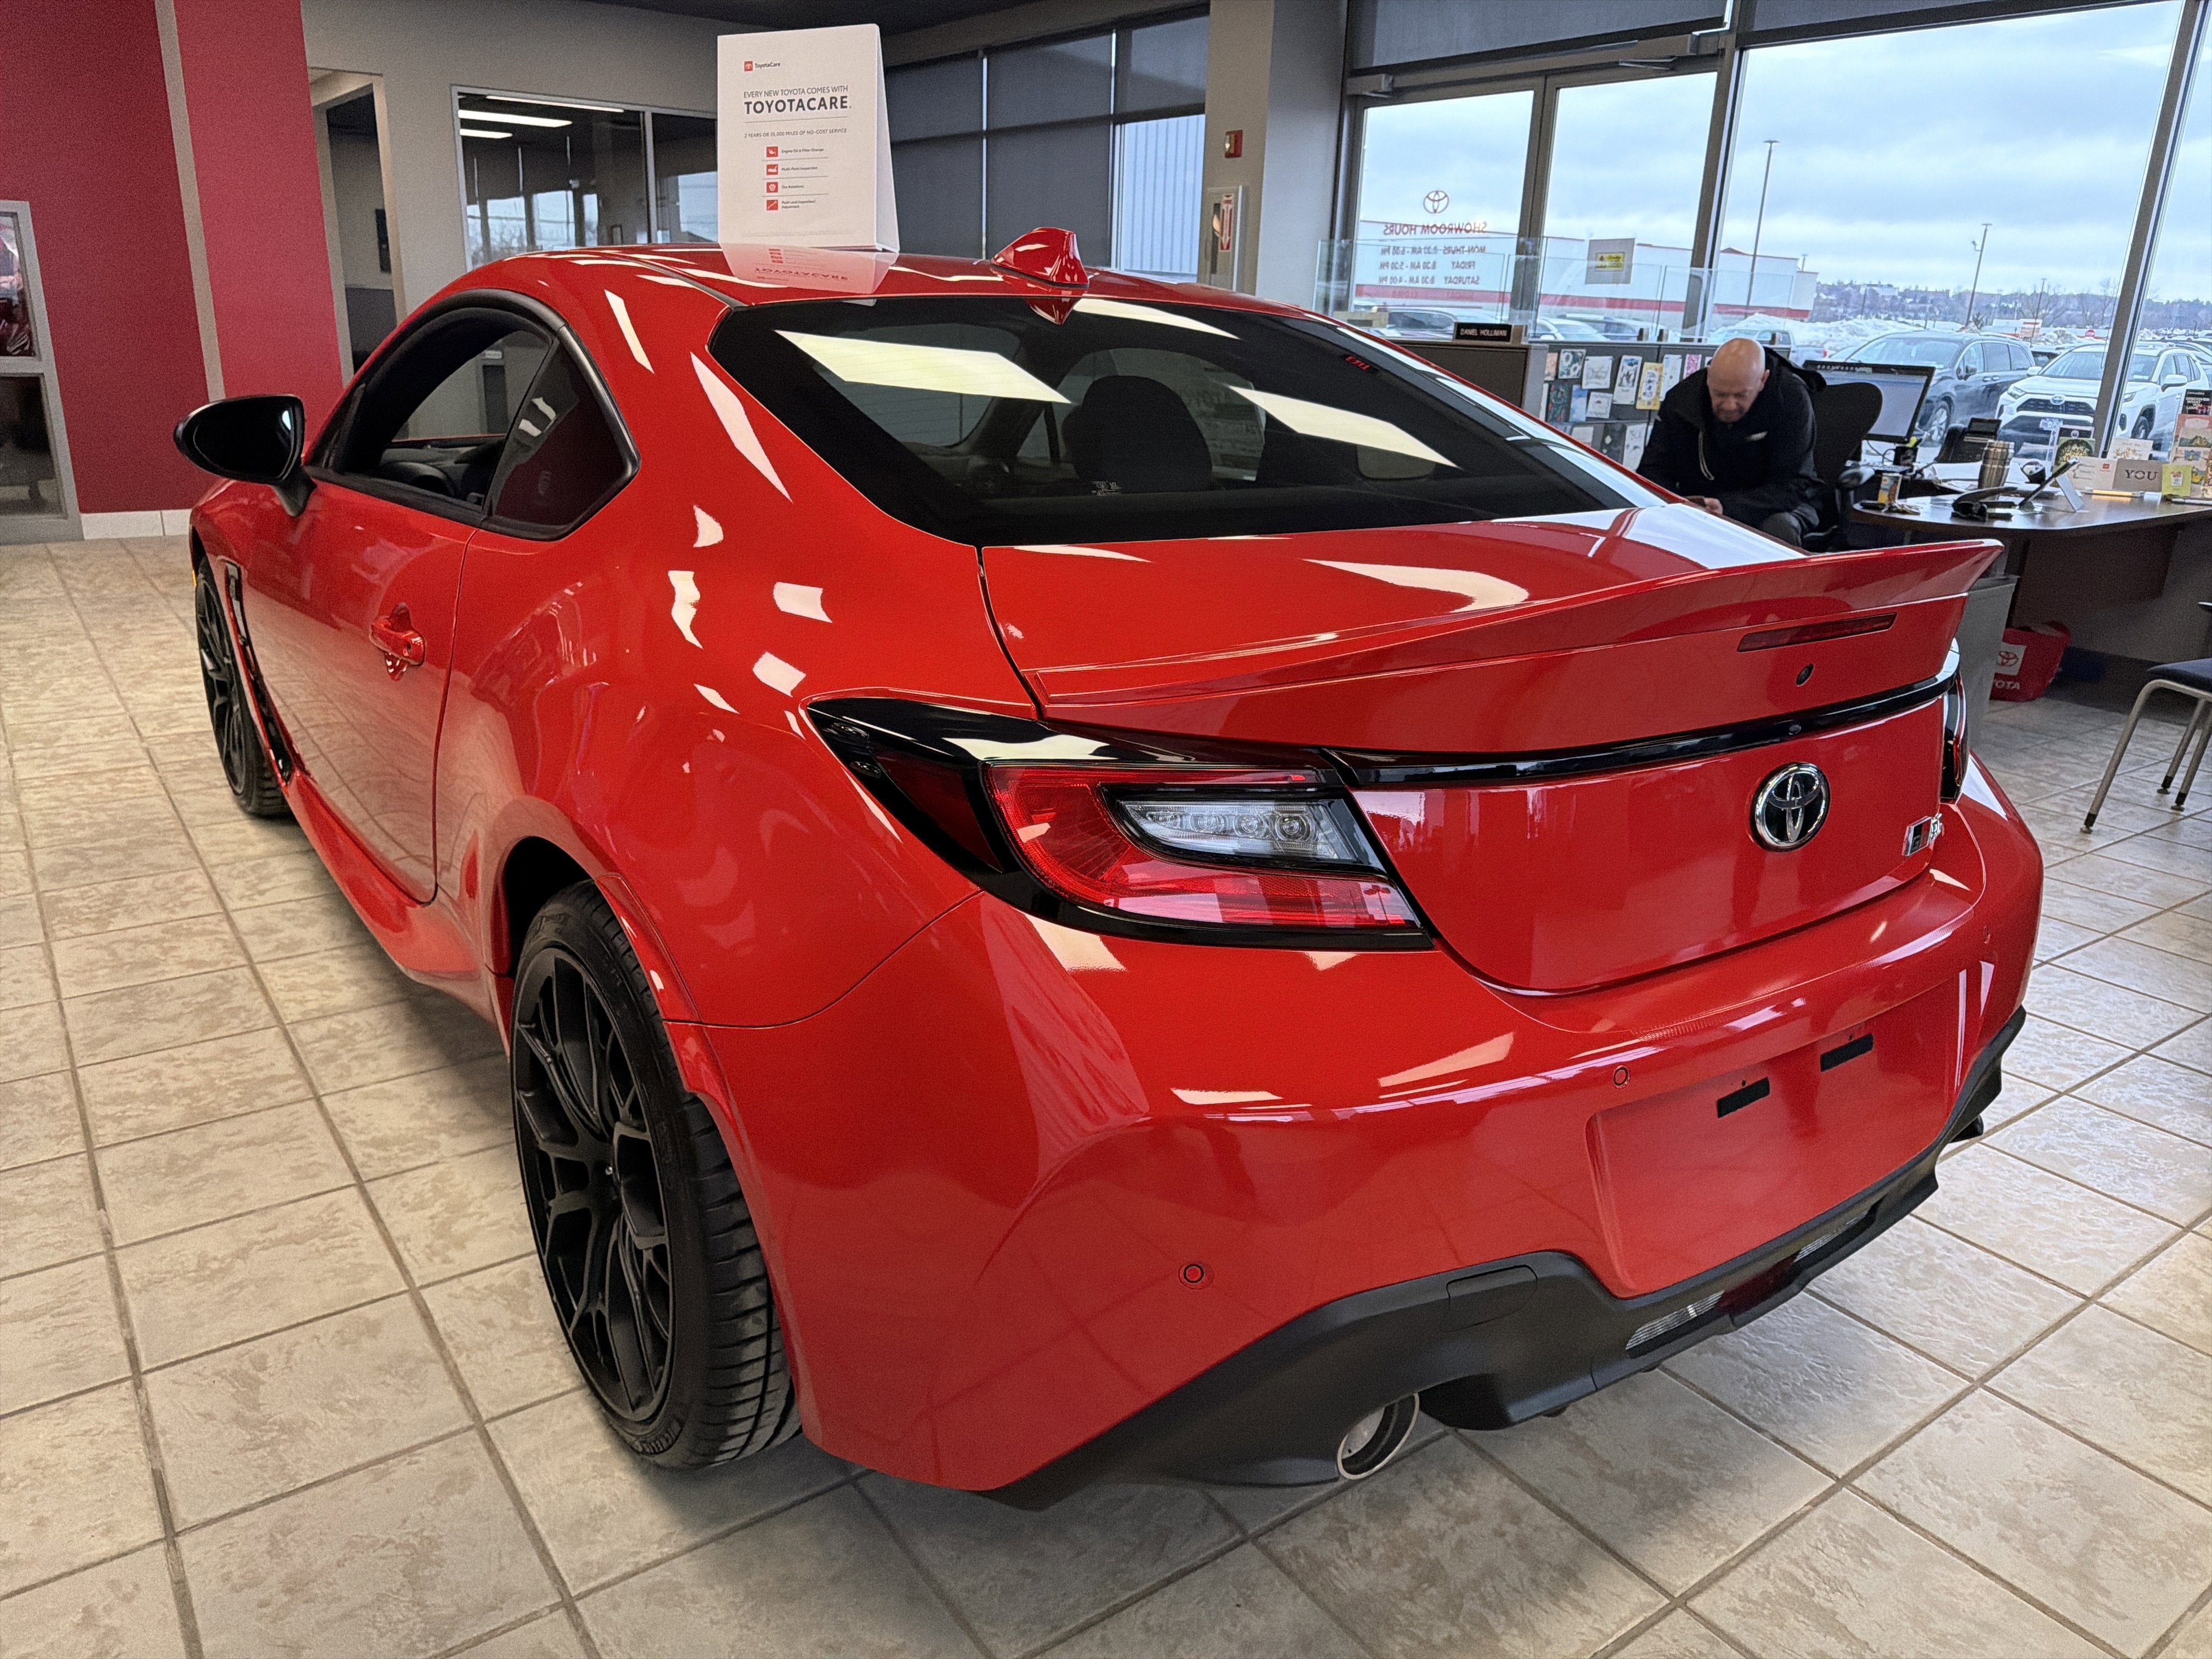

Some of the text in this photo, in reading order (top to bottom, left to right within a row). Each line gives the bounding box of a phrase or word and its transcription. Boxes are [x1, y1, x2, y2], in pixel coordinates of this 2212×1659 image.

[781, 88, 805, 96] TOYOTA
[806, 86, 830, 94] COMES
[2125, 469, 2158, 481] YOU
